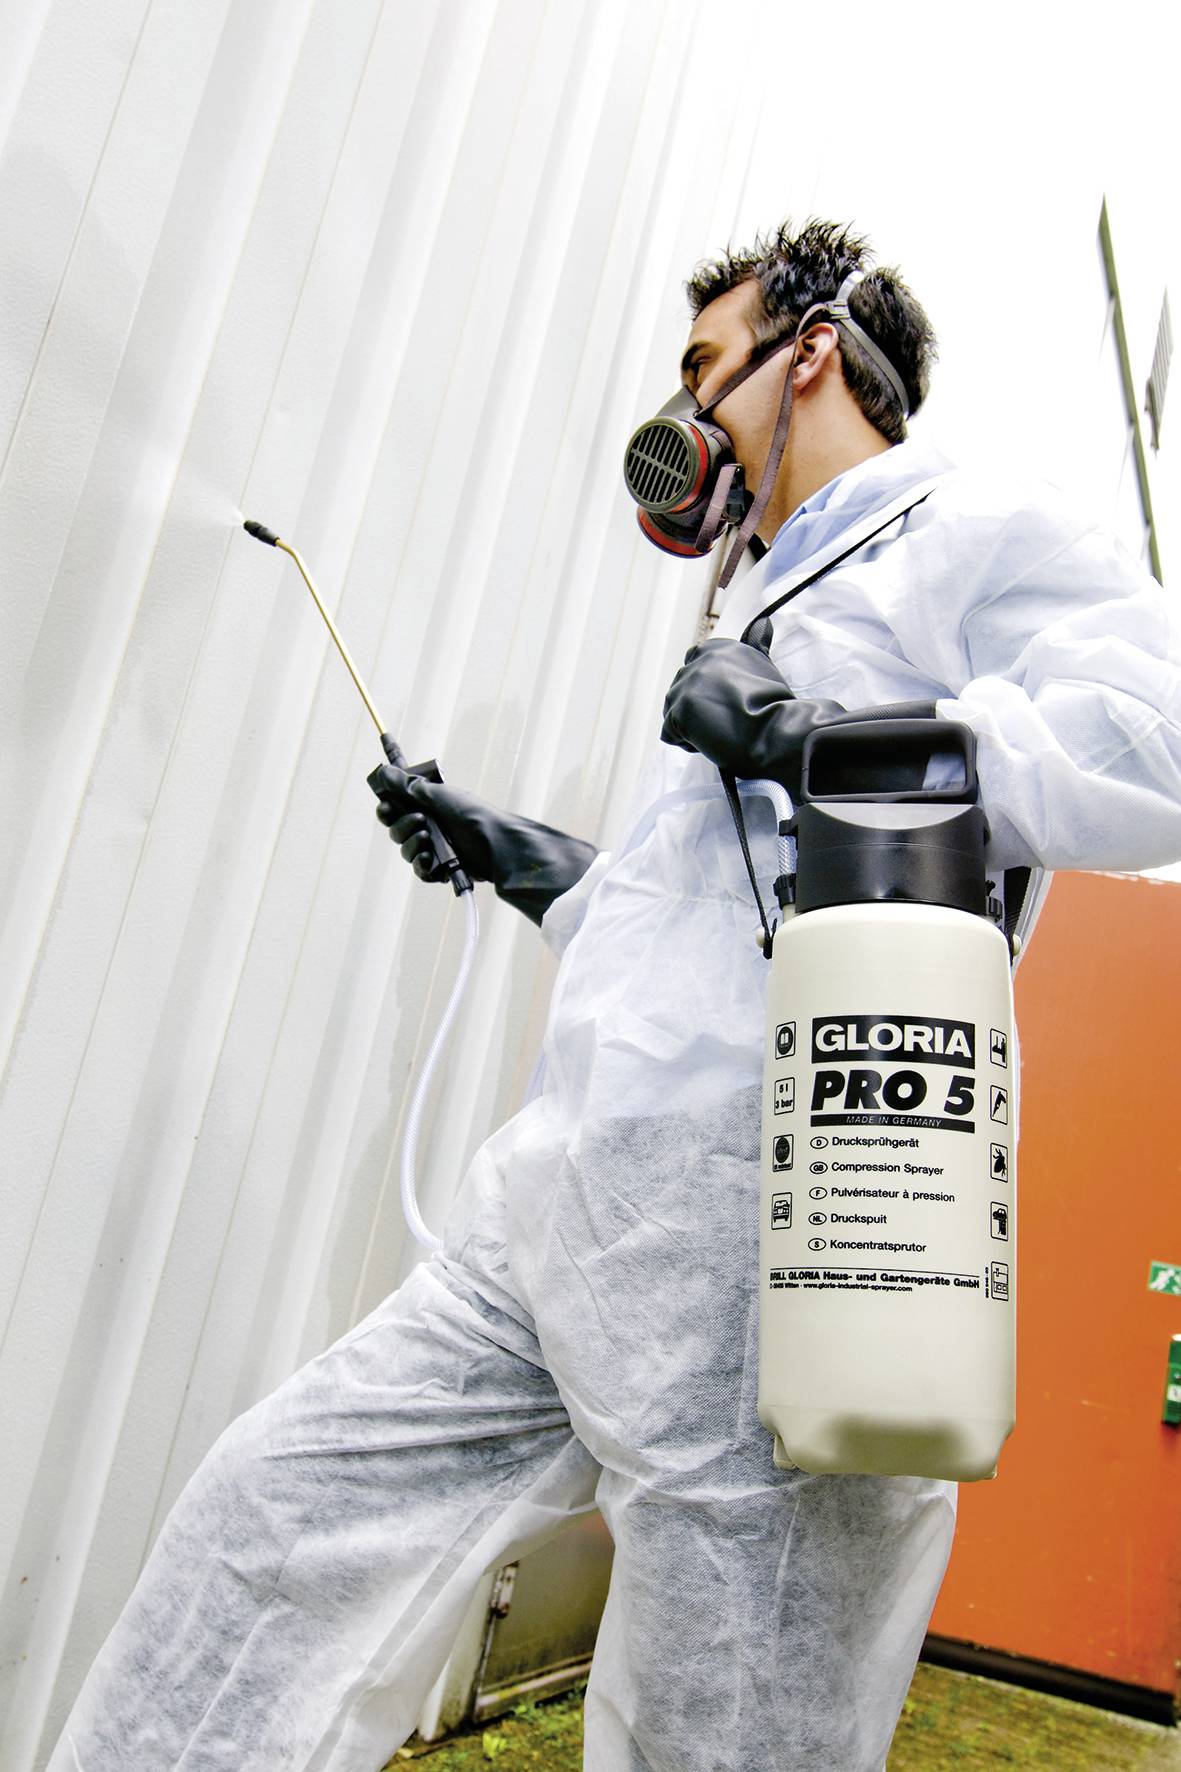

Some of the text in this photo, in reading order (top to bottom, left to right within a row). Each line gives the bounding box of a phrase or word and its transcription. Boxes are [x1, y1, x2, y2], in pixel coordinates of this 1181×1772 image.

[815, 1023, 972, 1058] GLORIA
[811, 1069, 976, 1116] PRO 5
[781, 1099, 793, 1108] bar
[846, 1116, 942, 1127] MADE IN GERMANY
[832, 1136, 919, 1149] Drucksprühgerät
[831, 1161, 901, 1173] Compression
[904, 1163, 944, 1176] Sprayer
[831, 1187, 900, 1198] Pulvérisateur
[903, 1189, 909, 1199] à
[912, 1191, 955, 1202] pression
[830, 1213, 887, 1225] Druckspuit
[830, 1240, 927, 1252] Koncentratsprutor
[788, 1271, 820, 1280] GLORIA
[823, 1271, 853, 1281] Haus-
[856, 1273, 876, 1281] und
[880, 1273, 950, 1286] Gartengeräte
[954, 1278, 980, 1289] GmbH
[803, 1283, 912, 1292] www.gloria-industrial-sprayer.com
